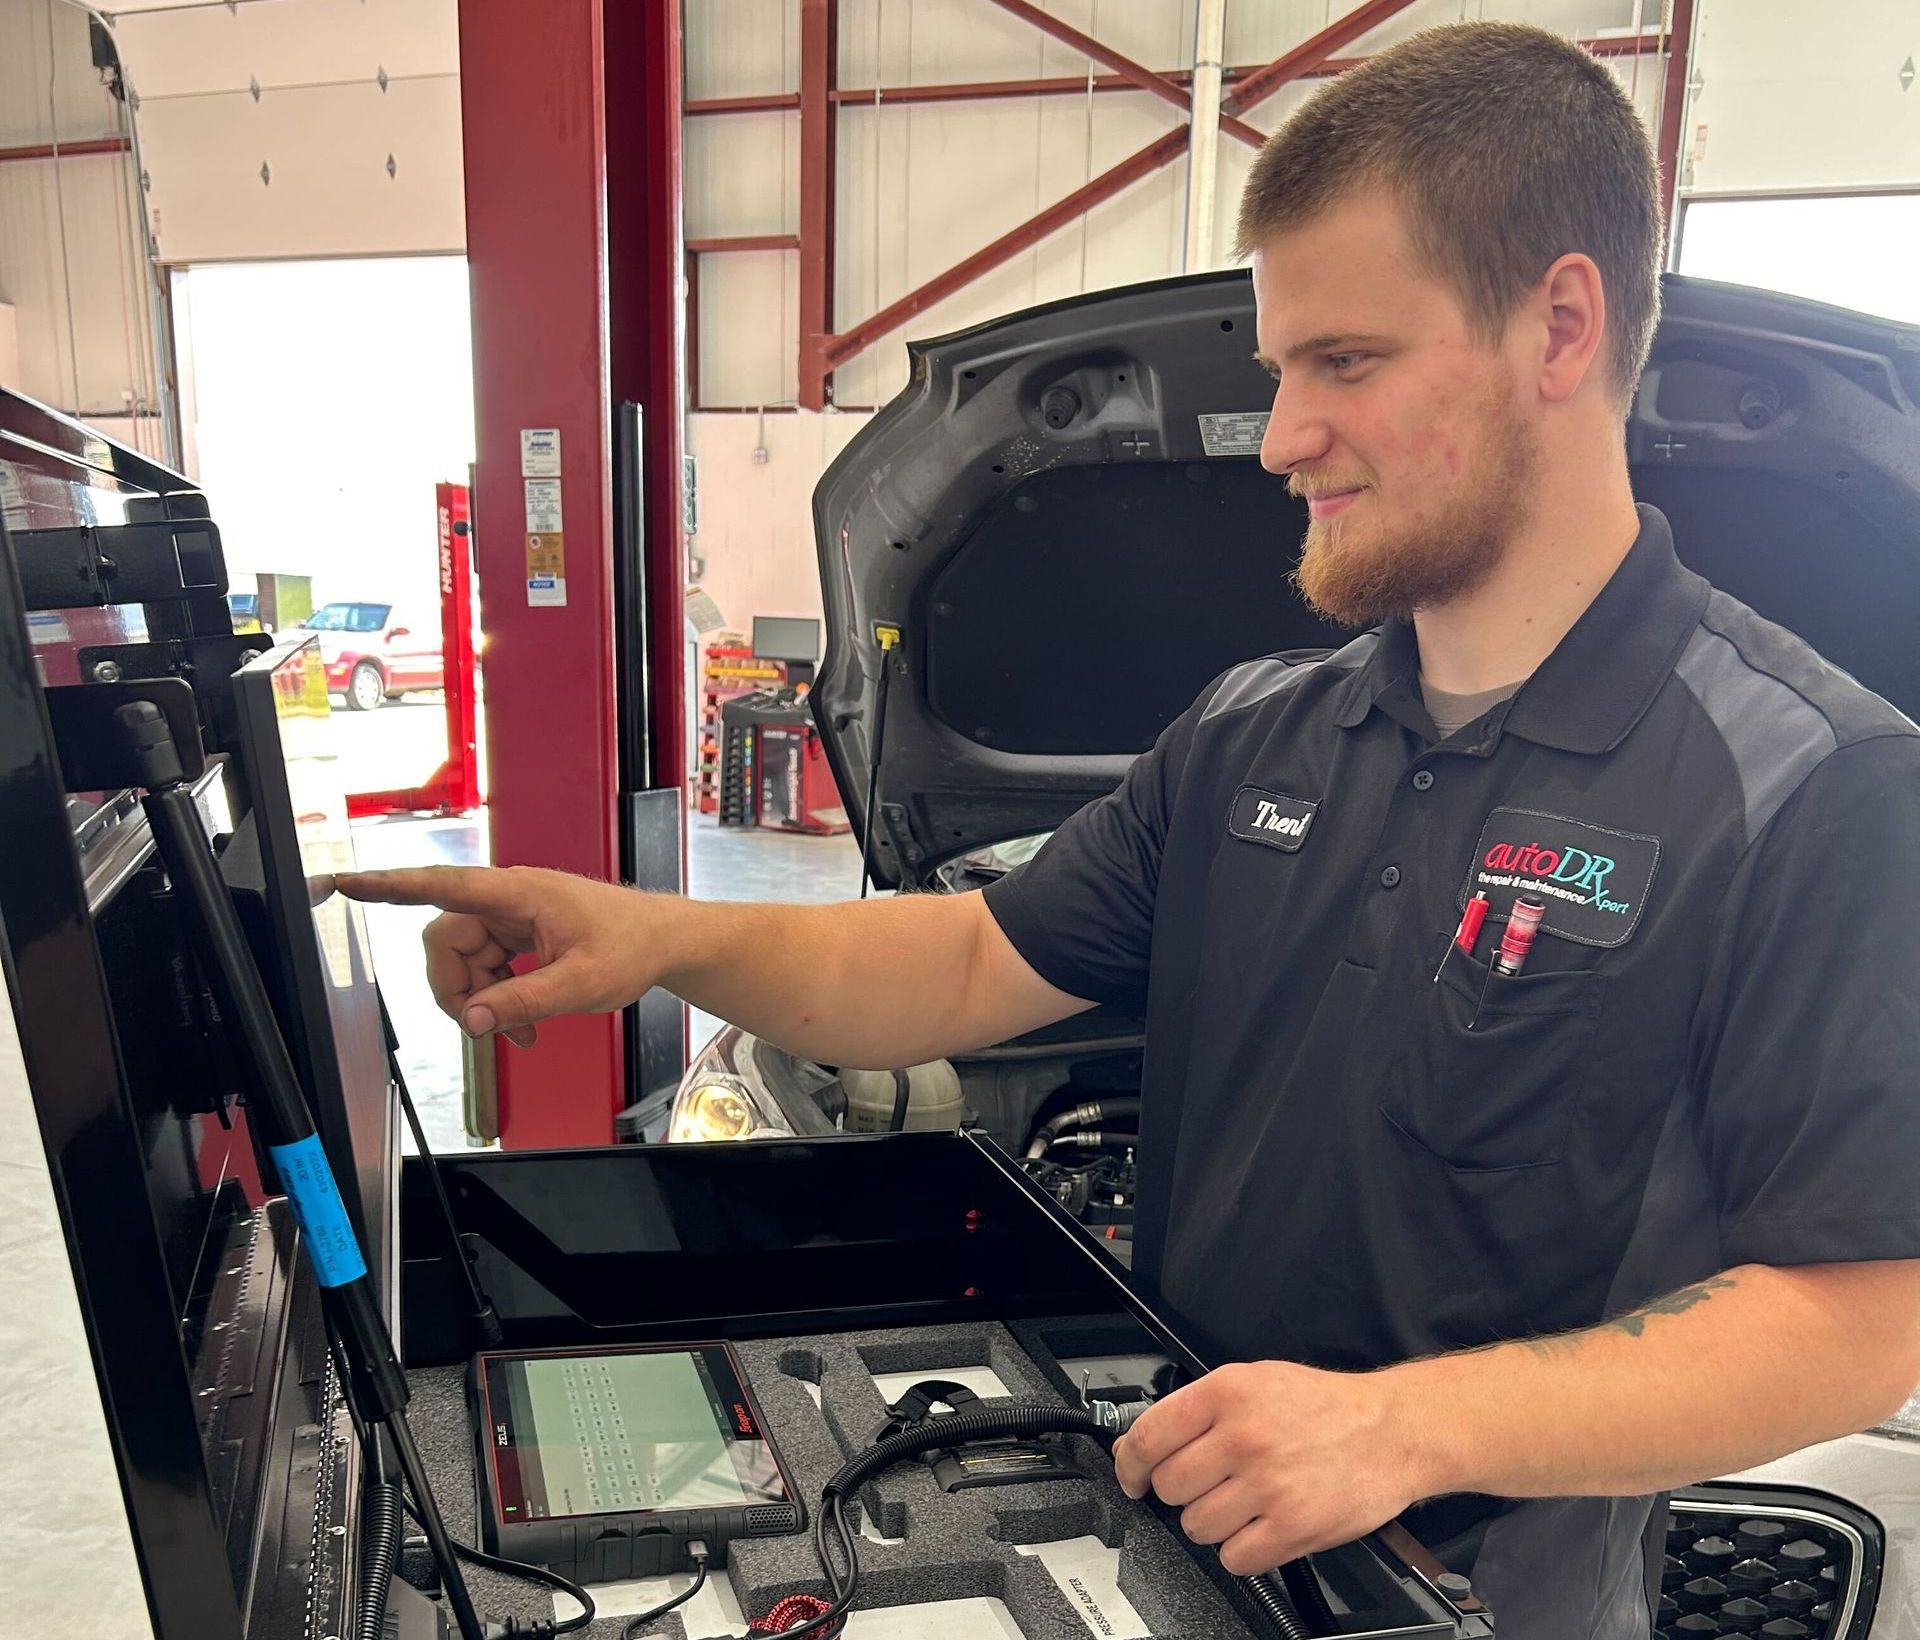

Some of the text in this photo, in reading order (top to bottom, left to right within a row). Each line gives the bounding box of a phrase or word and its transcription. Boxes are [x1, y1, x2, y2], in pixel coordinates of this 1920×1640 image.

[440, 506, 452, 594] HUNTER
[1251, 800, 1311, 837] Trent
[1478, 871, 1491, 883] the
[1490, 874, 1513, 887] repair
[1520, 879, 1585, 905] maintenance
[1069, 1578, 1115, 1636] PRESSURE ADAPTER
